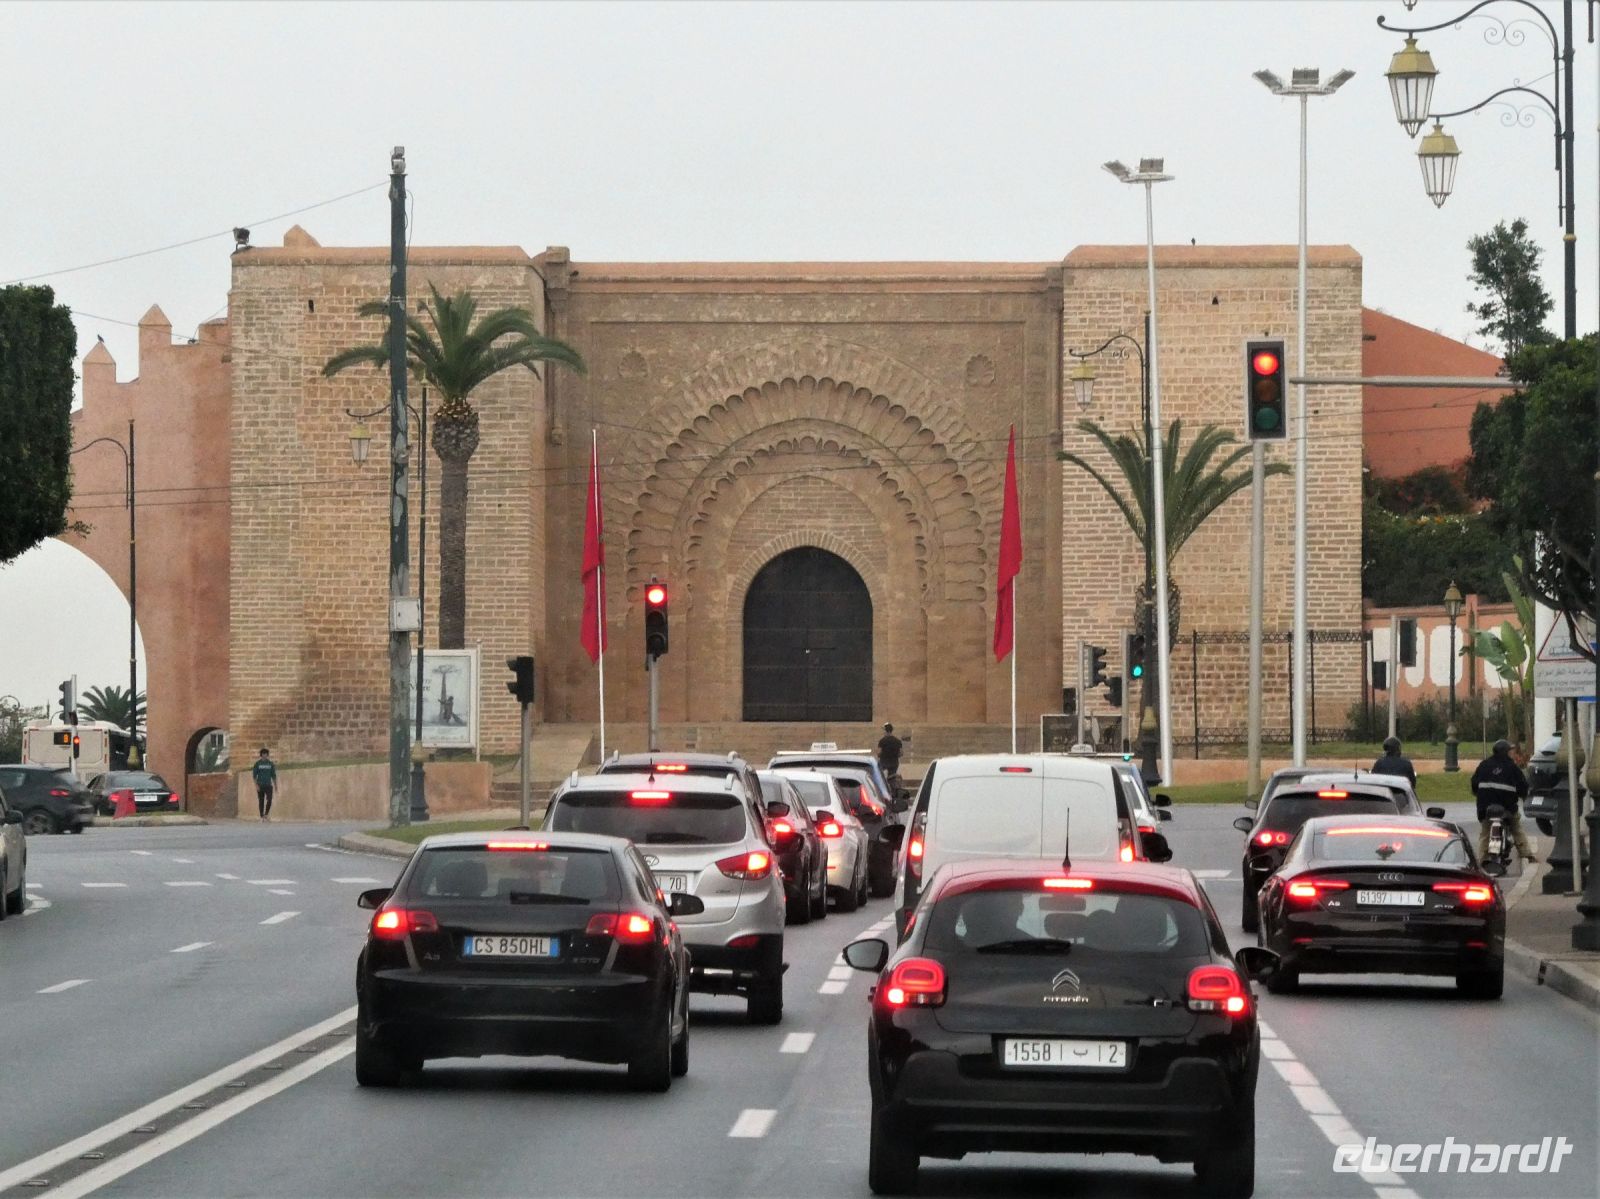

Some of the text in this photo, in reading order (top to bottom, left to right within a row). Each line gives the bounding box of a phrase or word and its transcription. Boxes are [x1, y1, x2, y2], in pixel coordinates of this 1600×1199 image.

[670, 877, 681, 890] 70
[1360, 891, 1386, 904] 61397
[474, 938, 548, 955] CS 850HL
[1012, 1042, 1051, 1061] 1558
[1109, 1044, 1118, 1063] 2
